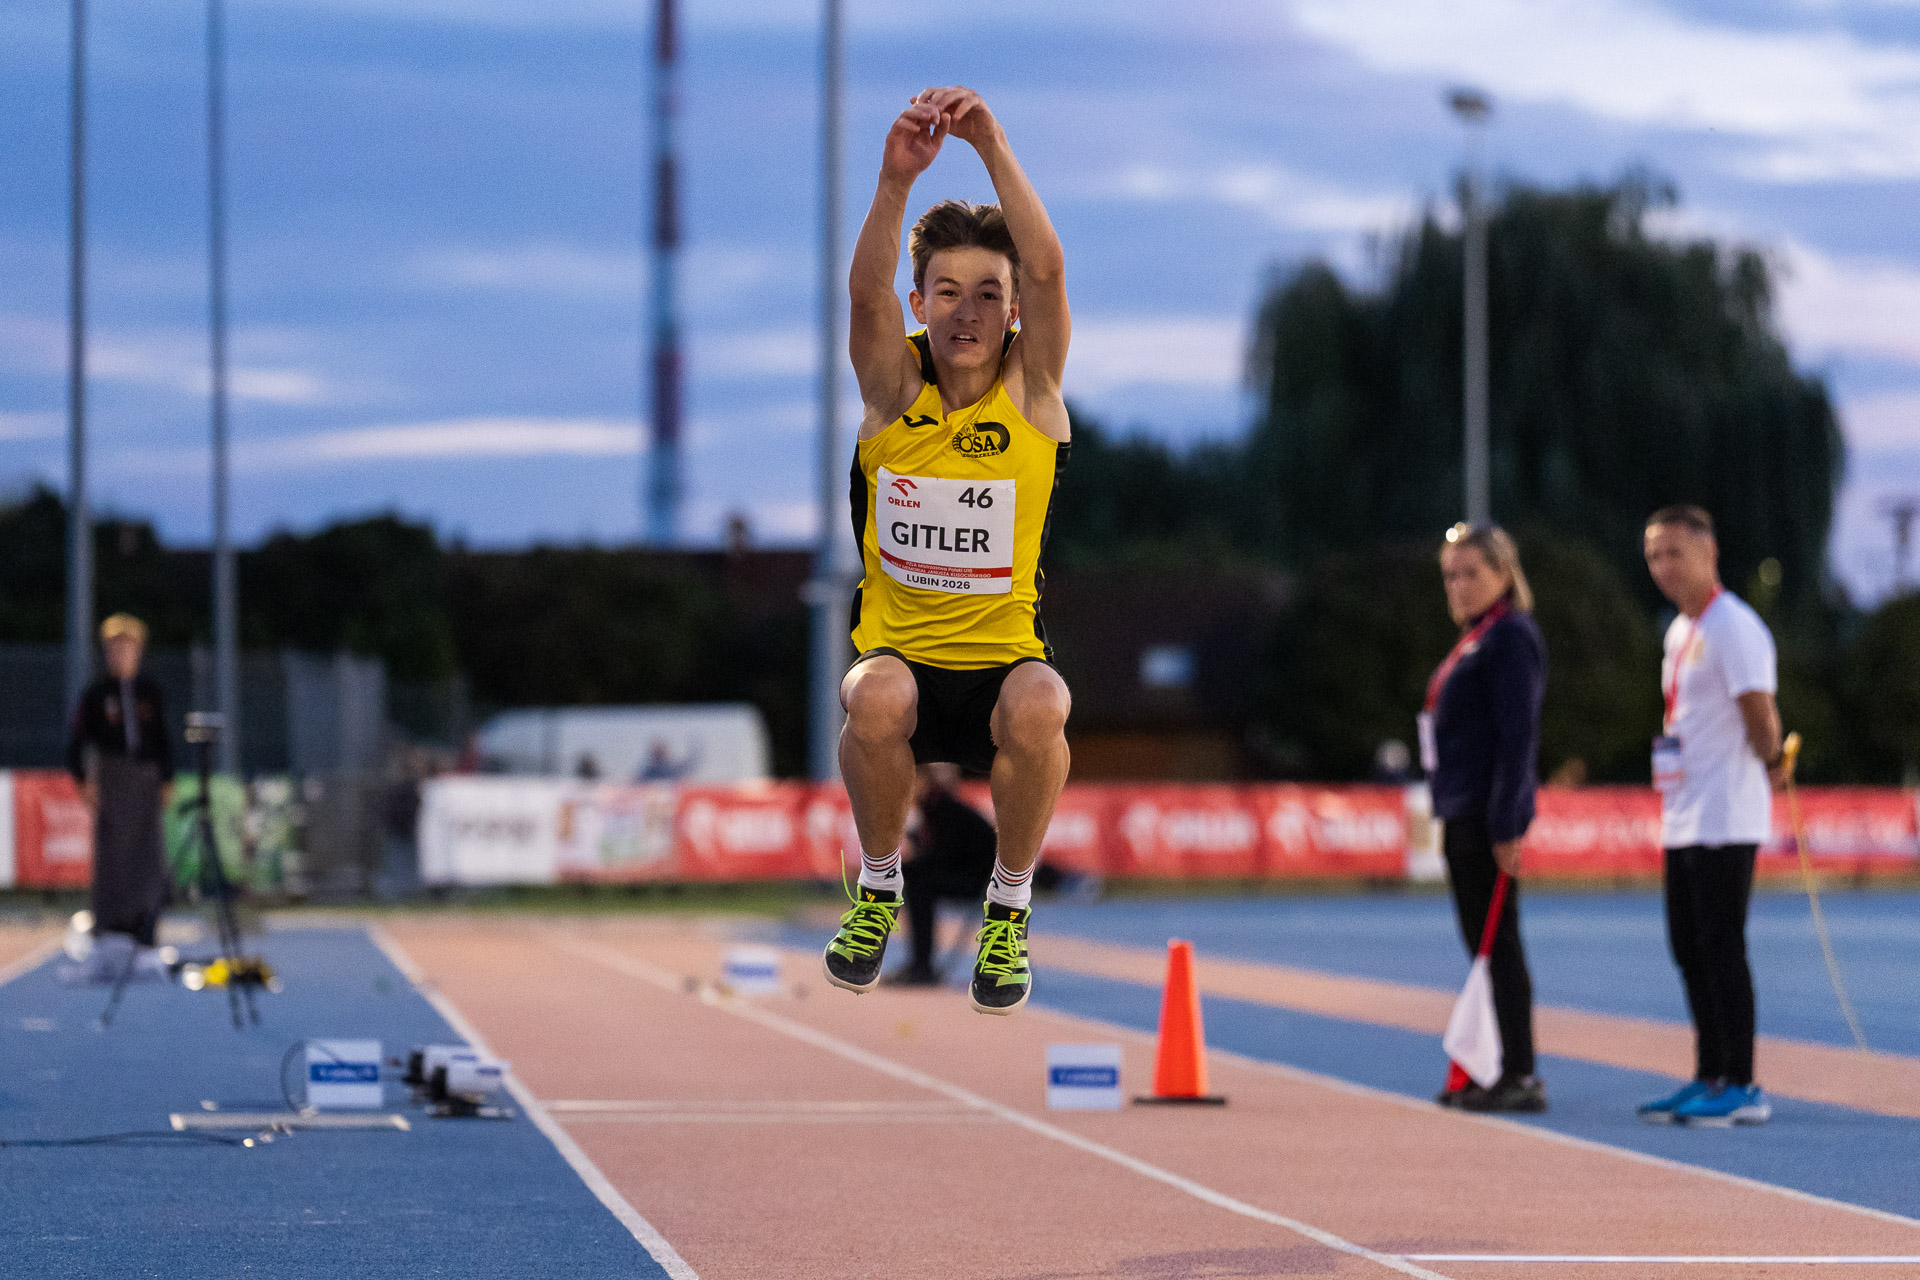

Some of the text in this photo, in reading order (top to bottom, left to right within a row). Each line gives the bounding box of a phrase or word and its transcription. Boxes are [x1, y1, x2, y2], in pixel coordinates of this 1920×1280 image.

[959, 435, 998, 453] OSA
[888, 496, 921, 508] ORLEN
[958, 487, 993, 509] 46
[891, 521, 990, 553] GITLER
[906, 574, 971, 590] LUBIN 2026
